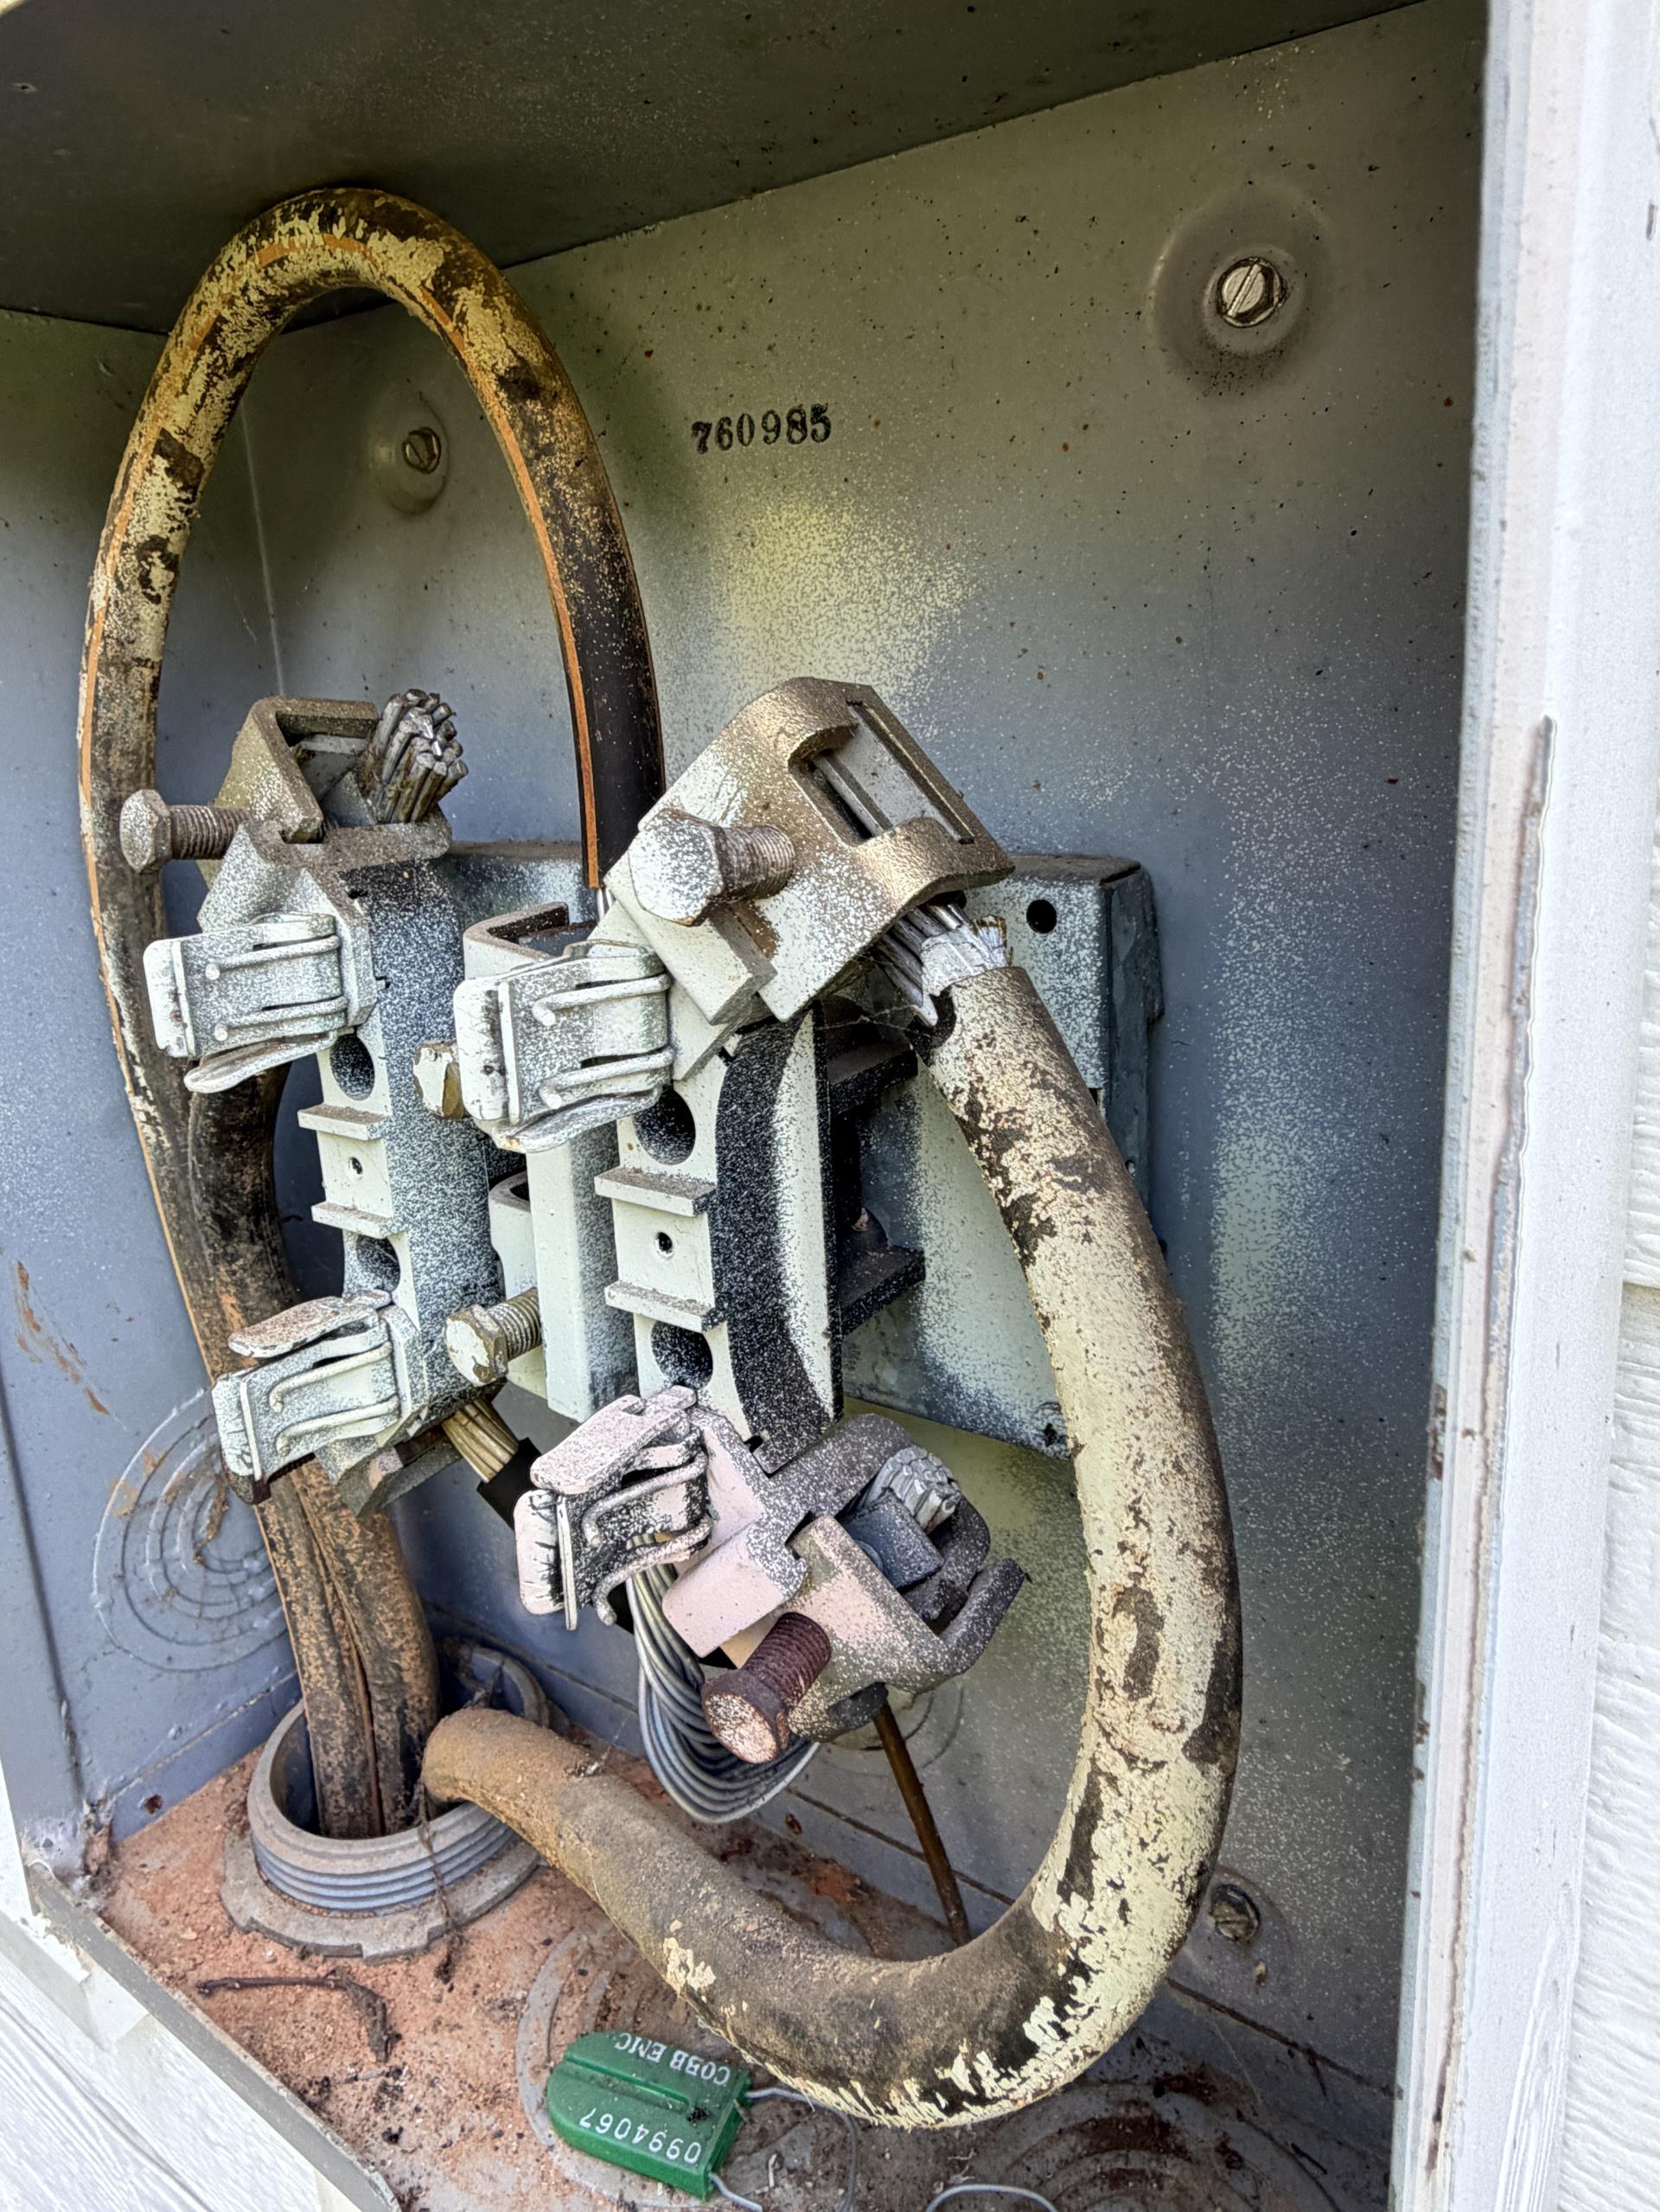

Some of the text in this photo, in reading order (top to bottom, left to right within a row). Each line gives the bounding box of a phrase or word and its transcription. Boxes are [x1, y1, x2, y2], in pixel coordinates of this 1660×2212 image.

[692, 403, 831, 455] 760985
[614, 2032, 731, 2086] COBB EMC
[579, 2107, 702, 2164] 0994067
